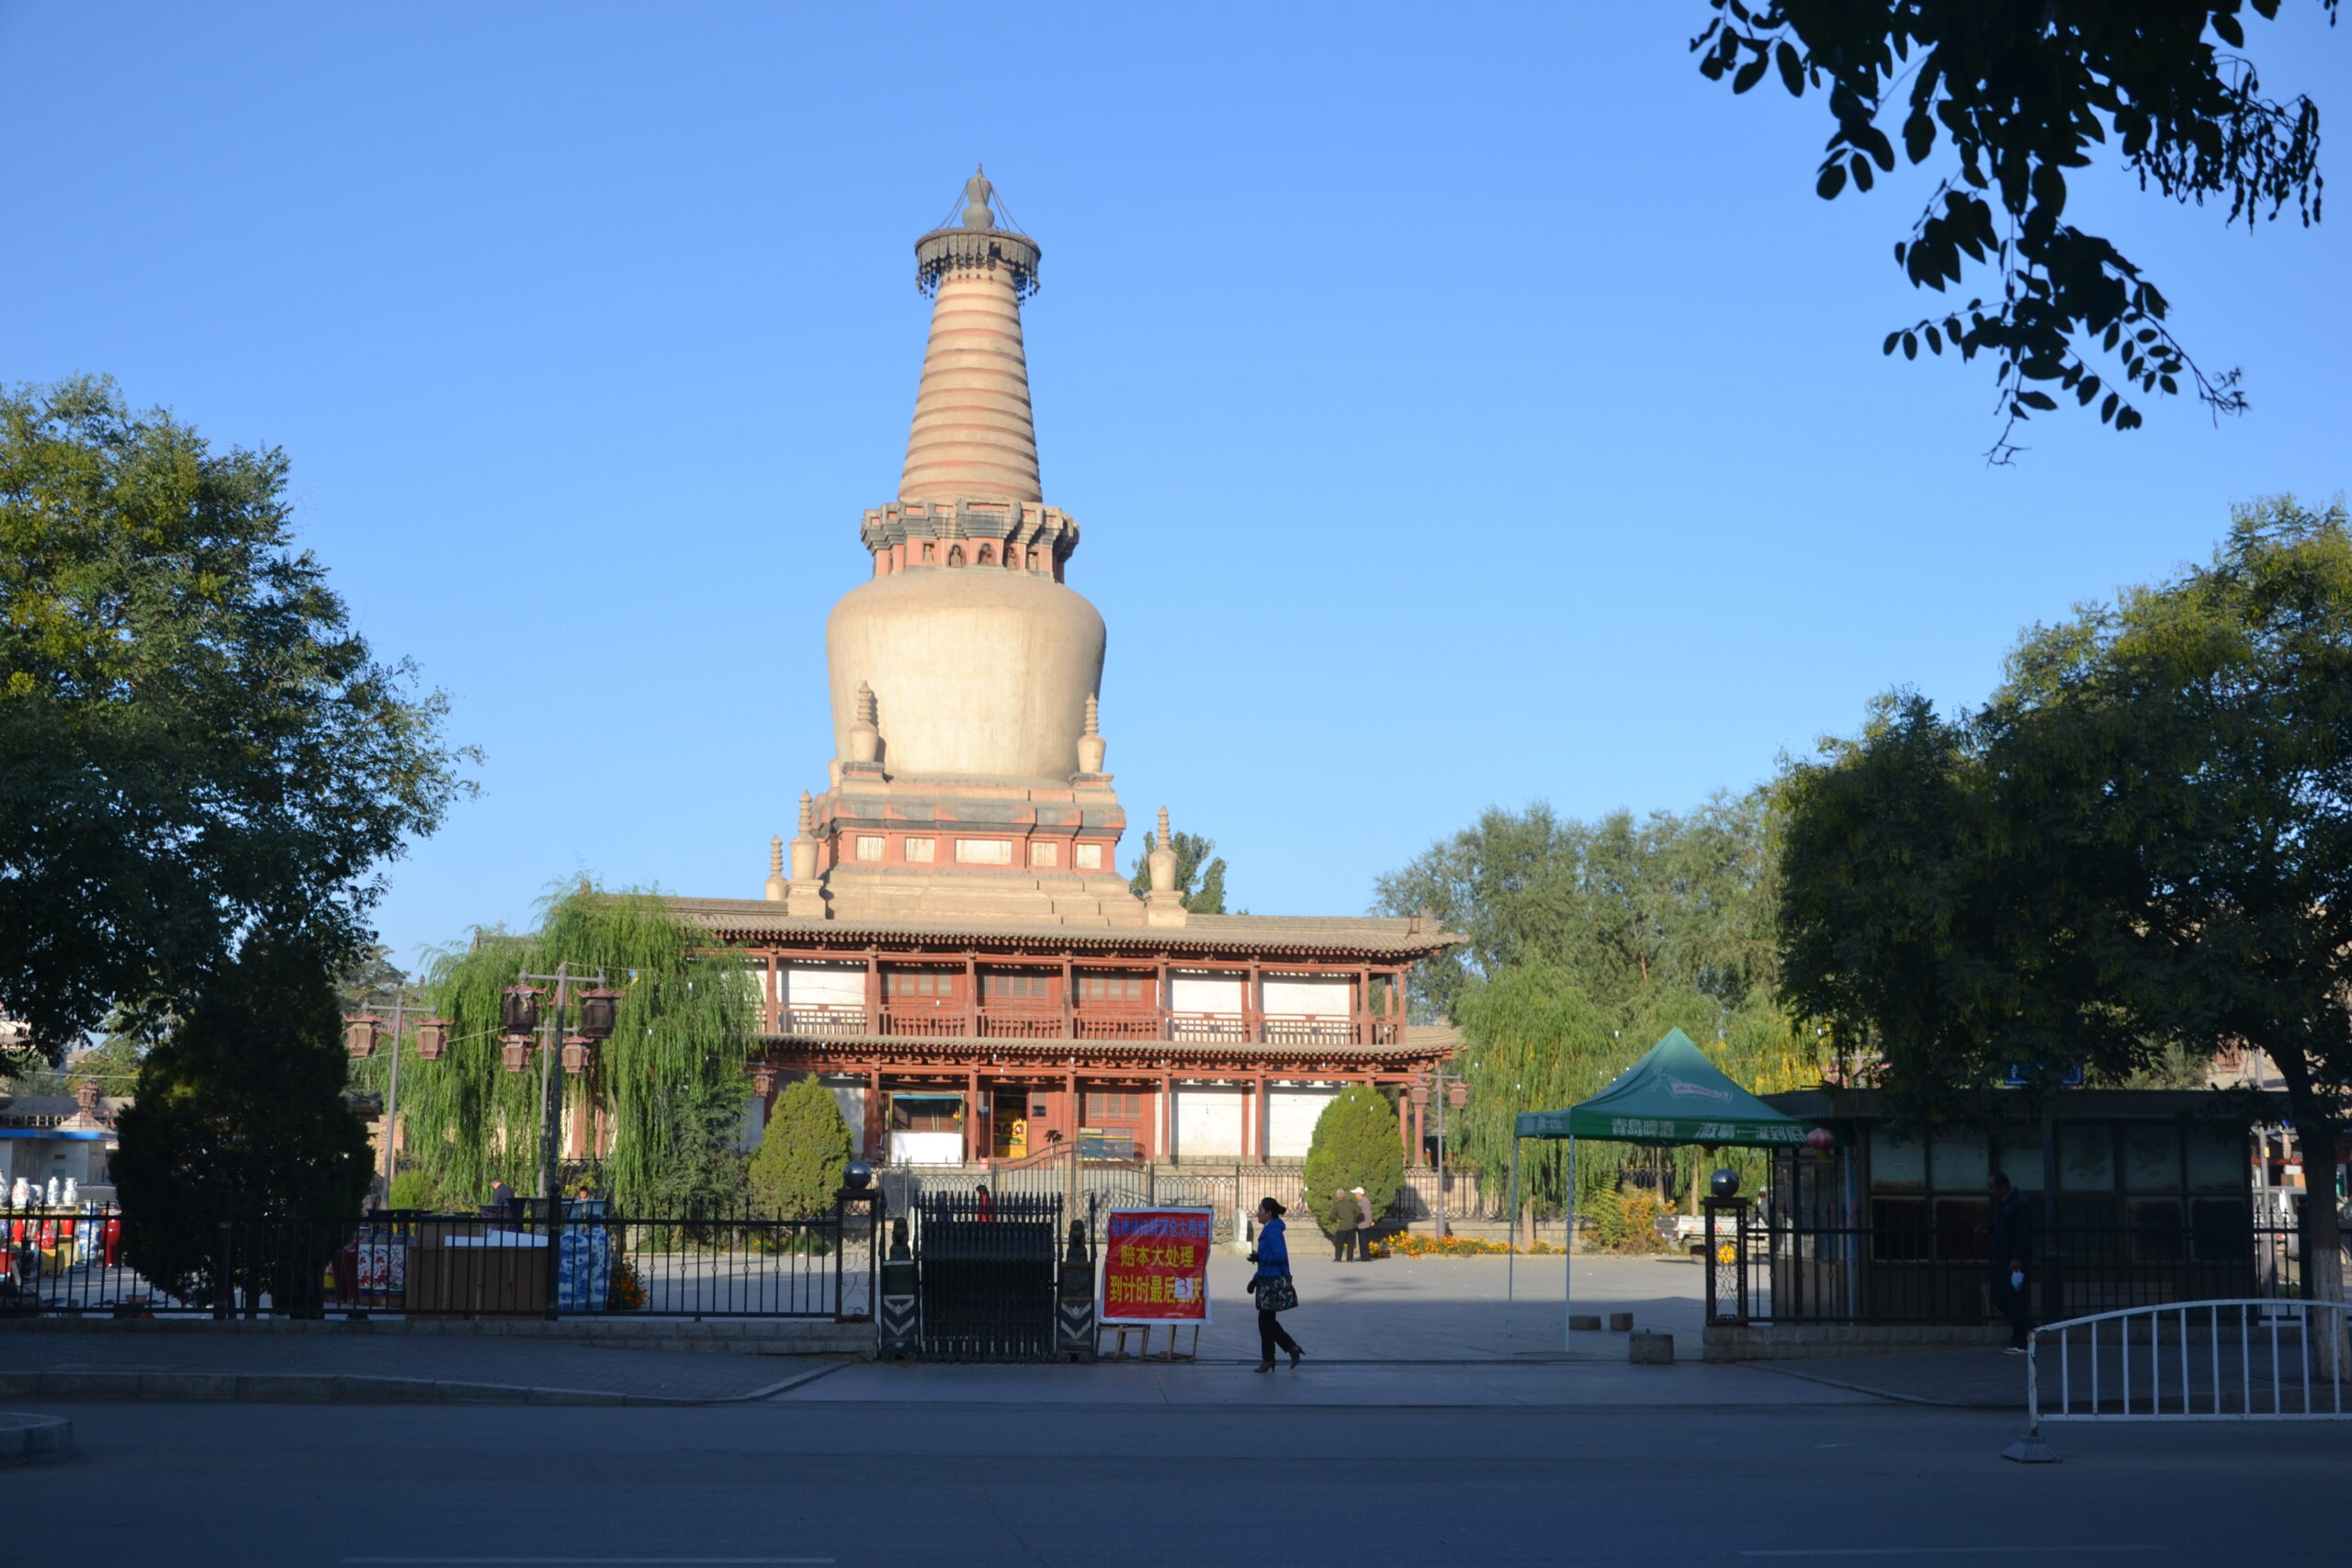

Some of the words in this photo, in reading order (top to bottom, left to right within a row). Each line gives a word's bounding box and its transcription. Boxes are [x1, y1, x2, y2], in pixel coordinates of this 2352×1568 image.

[1611, 1118, 1674, 1138] 青岛啤酒
[1121, 1245, 1194, 1268] 赔本大处理
